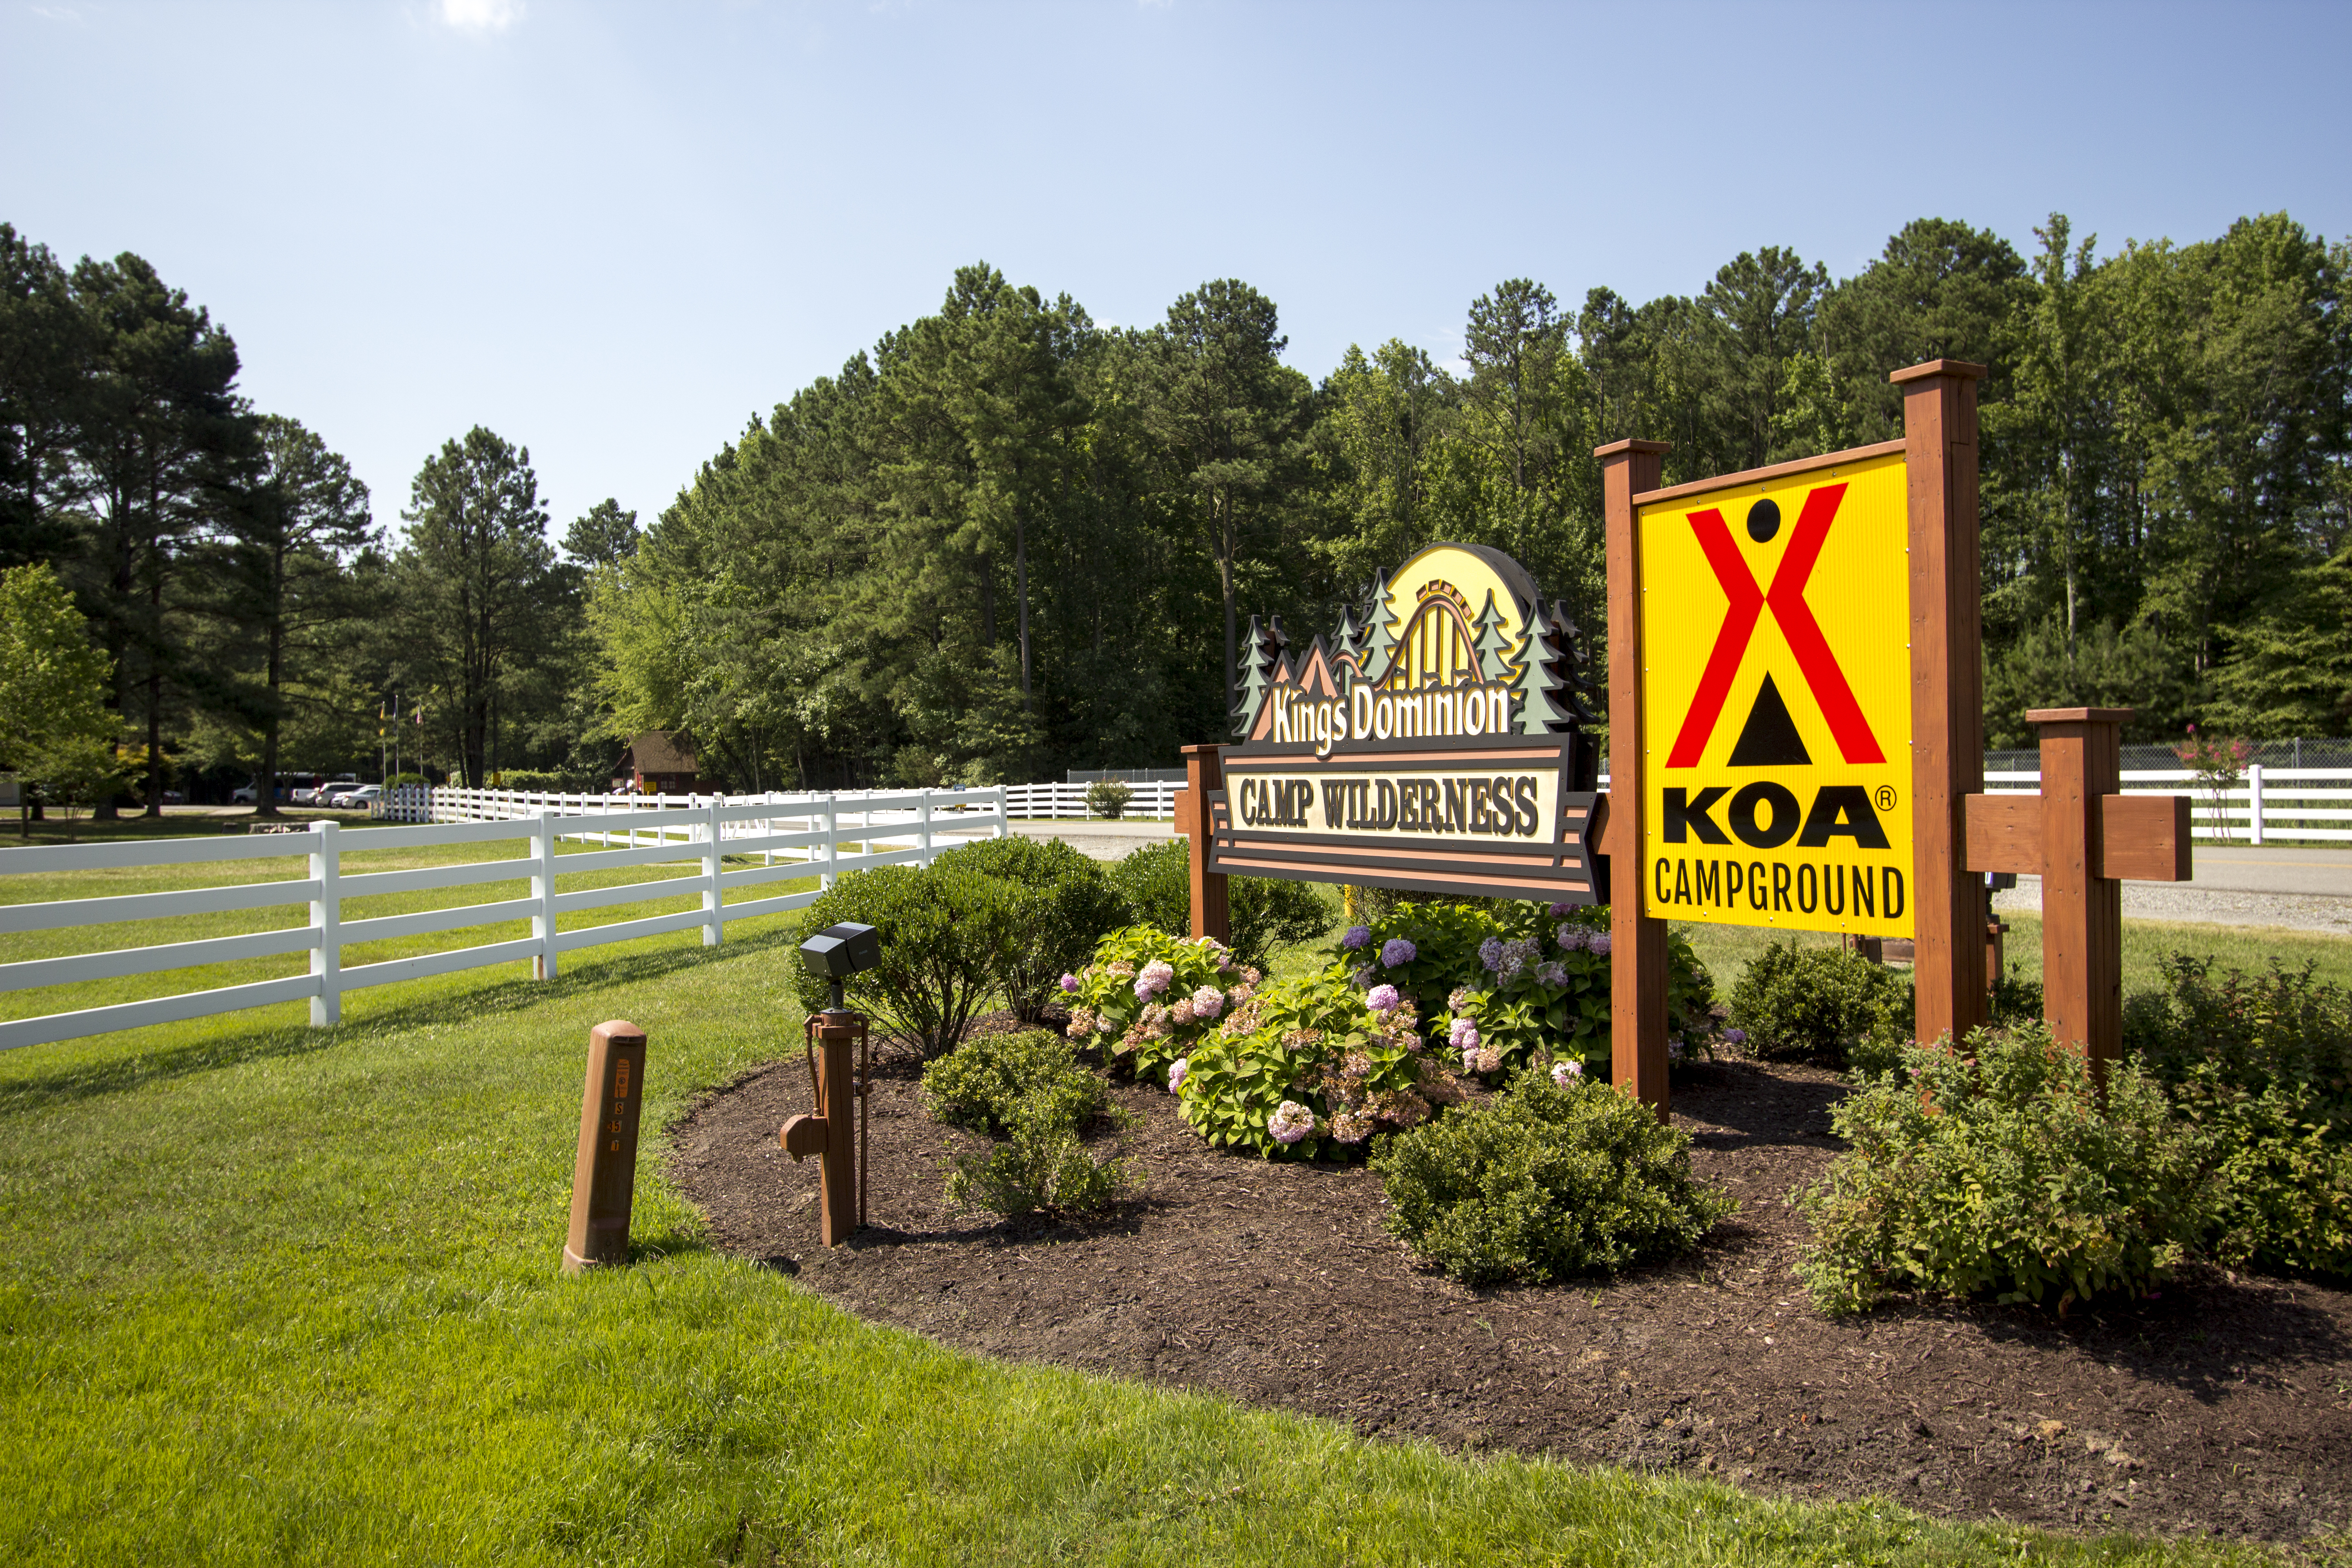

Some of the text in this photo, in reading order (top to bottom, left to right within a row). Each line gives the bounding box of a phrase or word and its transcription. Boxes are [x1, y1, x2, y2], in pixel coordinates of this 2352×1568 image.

[1273, 674, 1509, 756] Kings Dominion
[1240, 776, 1539, 836] CAMP WILDERNESS
[1663, 781, 1891, 849] KOA
[1656, 858, 1904, 919] CAMPGROUND
[617, 1103, 622, 1113] S
